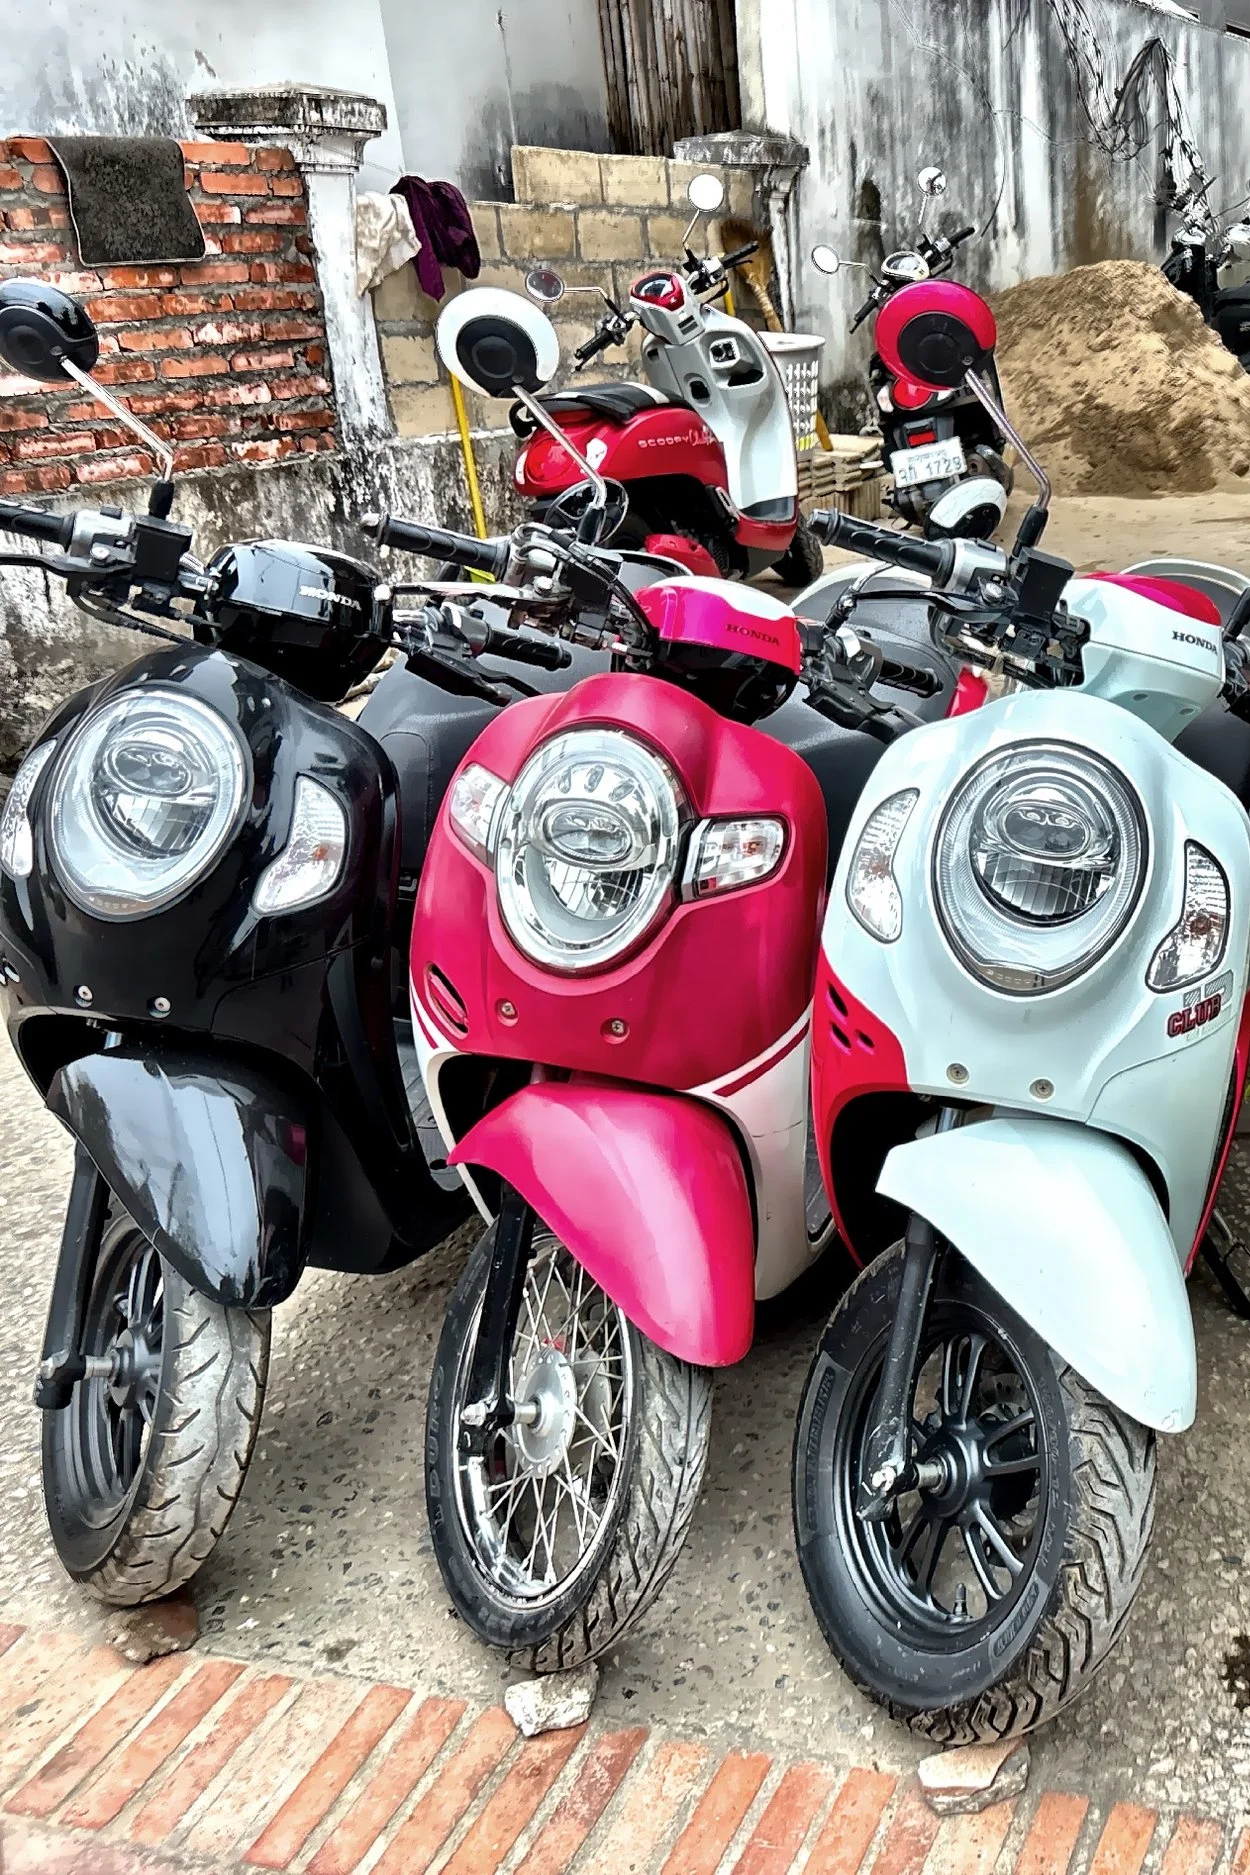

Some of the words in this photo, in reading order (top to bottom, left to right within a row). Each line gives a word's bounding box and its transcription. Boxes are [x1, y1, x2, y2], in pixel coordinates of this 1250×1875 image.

[638, 436, 689, 449] SCOOPY
[299, 585, 362, 611] HONDA
[726, 624, 780, 646] HONDA
[1172, 631, 1218, 656] HONDA
[1167, 993, 1221, 1038] CLUB
